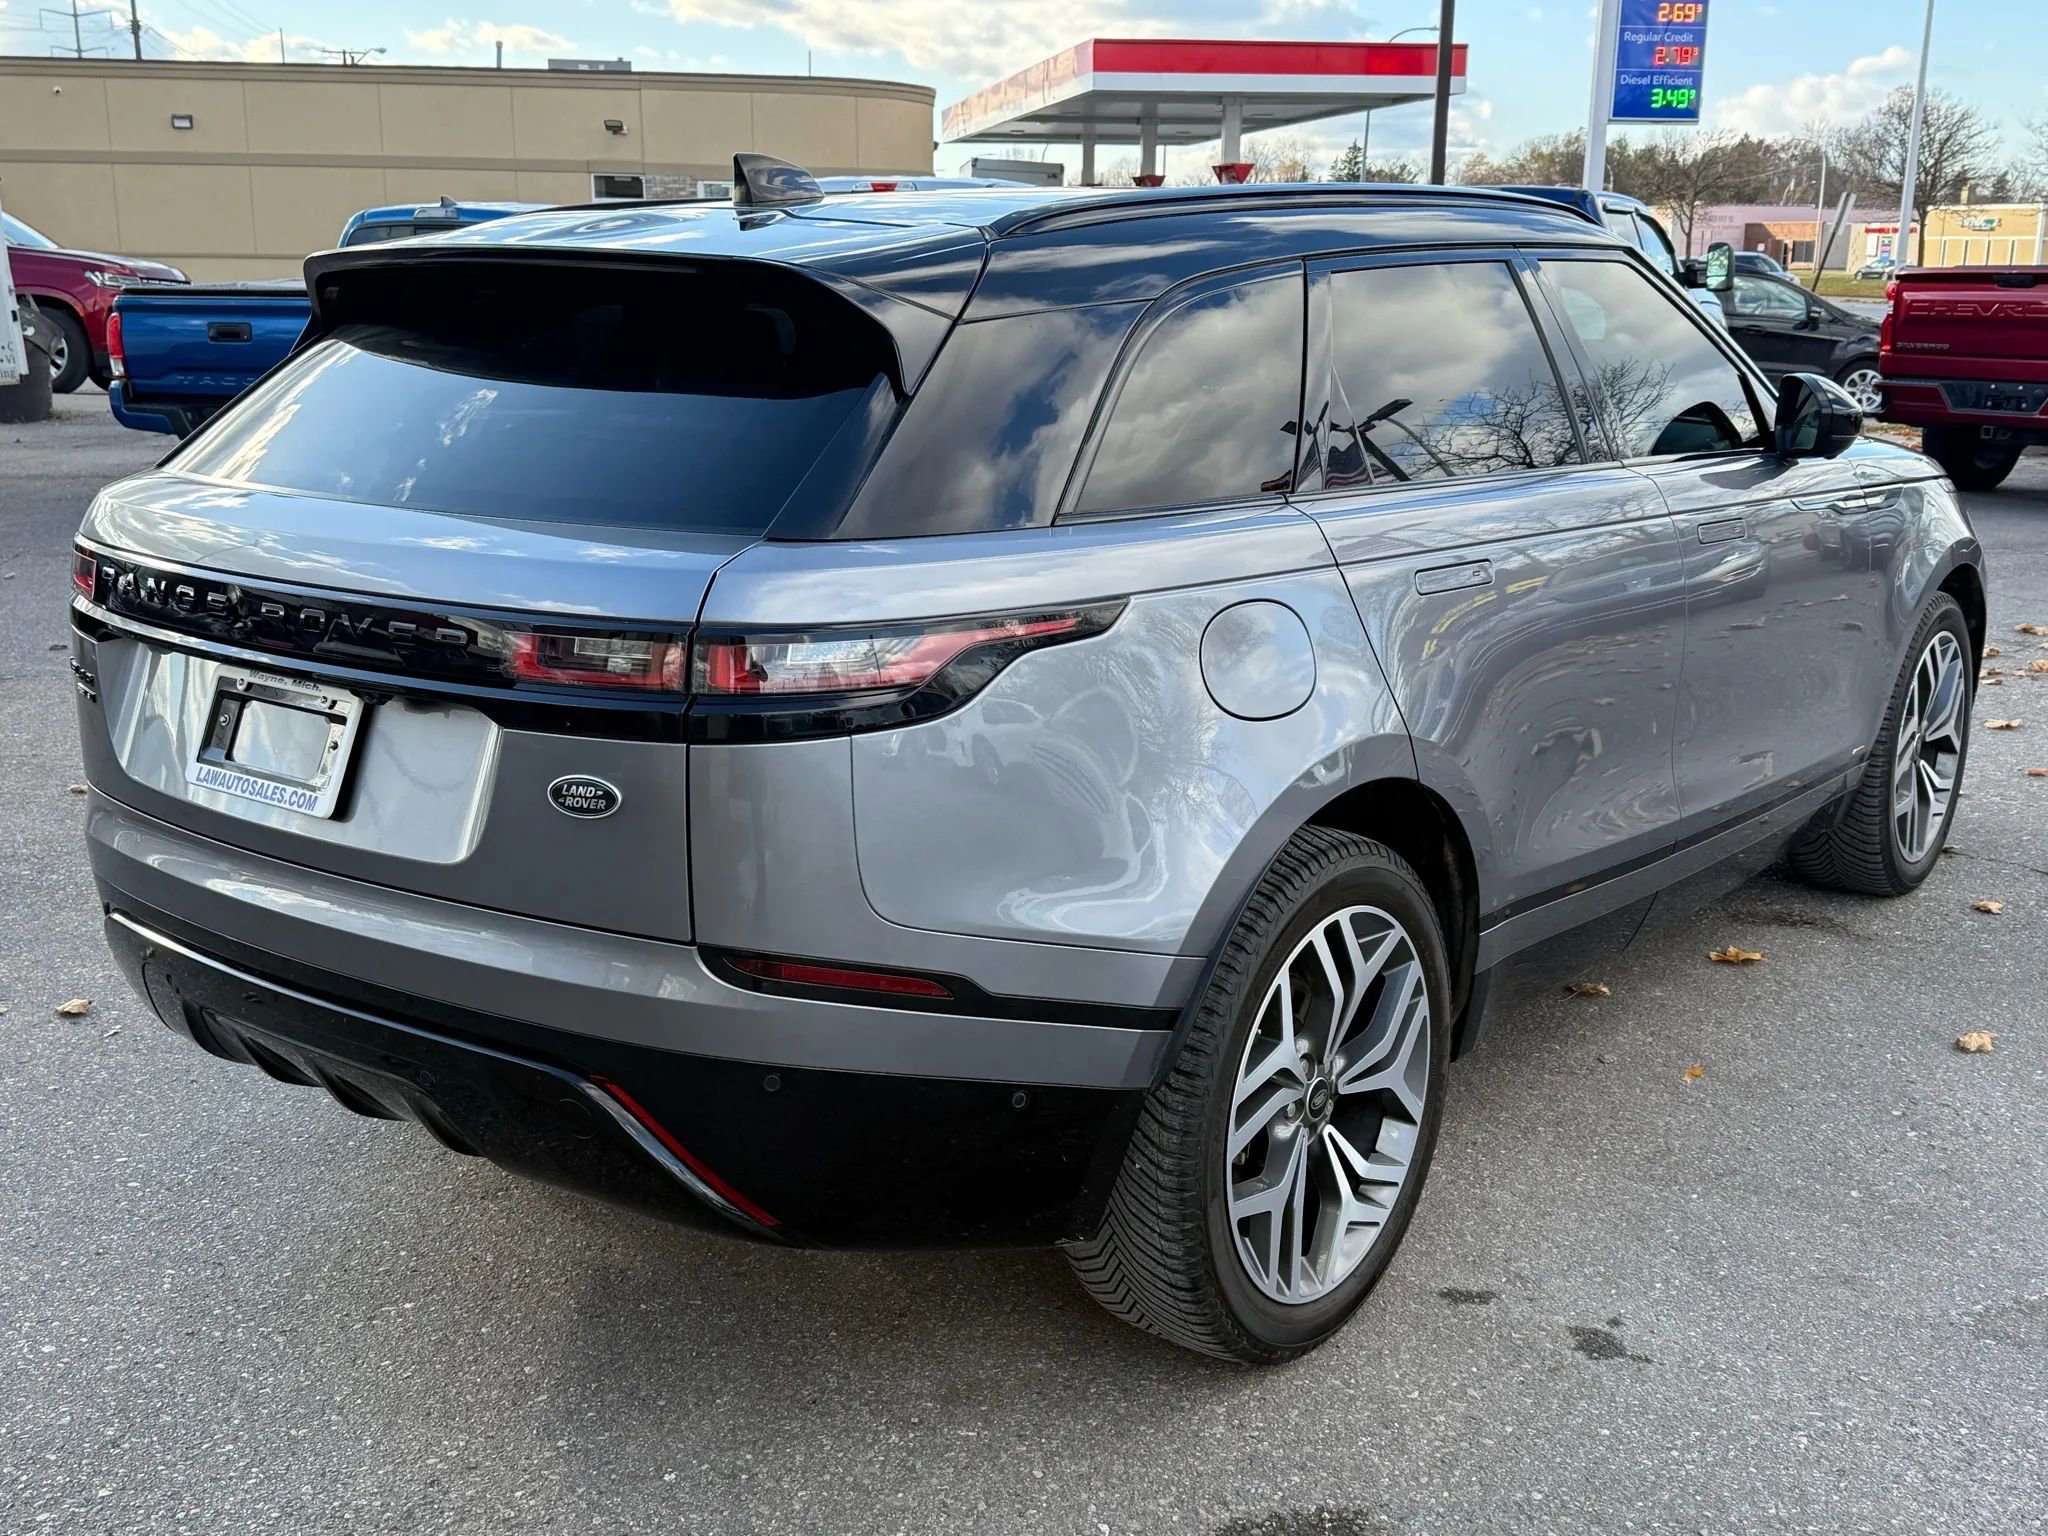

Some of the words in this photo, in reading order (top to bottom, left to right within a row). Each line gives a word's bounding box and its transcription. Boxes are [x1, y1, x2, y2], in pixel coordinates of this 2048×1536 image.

[1624, 31, 1661, 44] Regular
[1664, 32, 1693, 42] Credit
[1620, 74, 1650, 85] Diesel
[1653, 75, 1693, 86] Efficient
[102, 566, 228, 616] RANGE
[260, 602, 469, 656] ROVER
[291, 679, 323, 693] Mich.
[195, 766, 319, 813] LAWAUTOSALES.COM
[562, 784, 595, 797] LAND
[565, 797, 606, 809] ROVER
